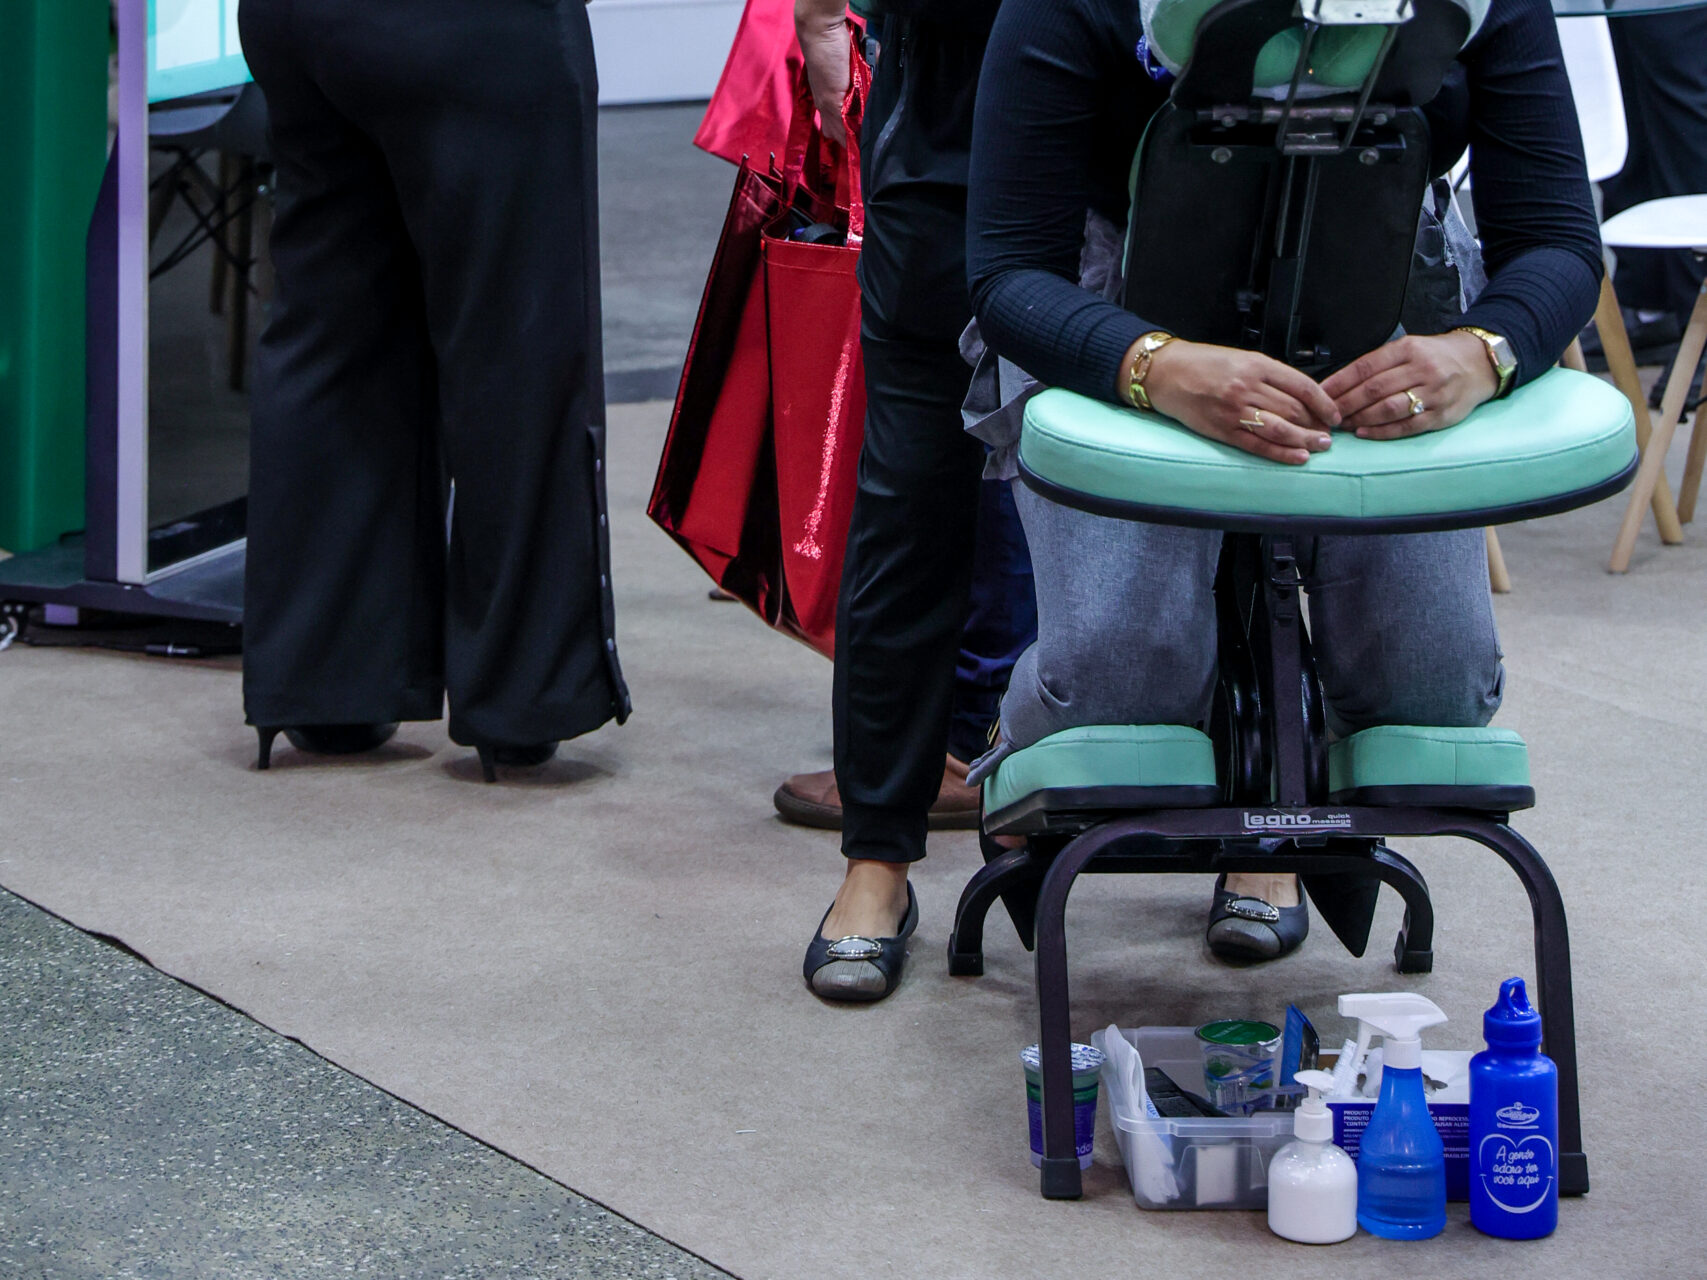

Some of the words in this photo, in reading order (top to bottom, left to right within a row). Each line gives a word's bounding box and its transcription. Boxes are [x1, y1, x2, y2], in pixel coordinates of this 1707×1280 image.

[1243, 812, 1312, 828] legno
[1496, 1145, 1506, 1161] A
[1508, 1149, 1535, 1164] gente
[1492, 1163, 1523, 1174] adora
[1525, 1163, 1538, 1173] ter
[1493, 1175, 1515, 1185] você
[1517, 1174, 1540, 1189] aqui
